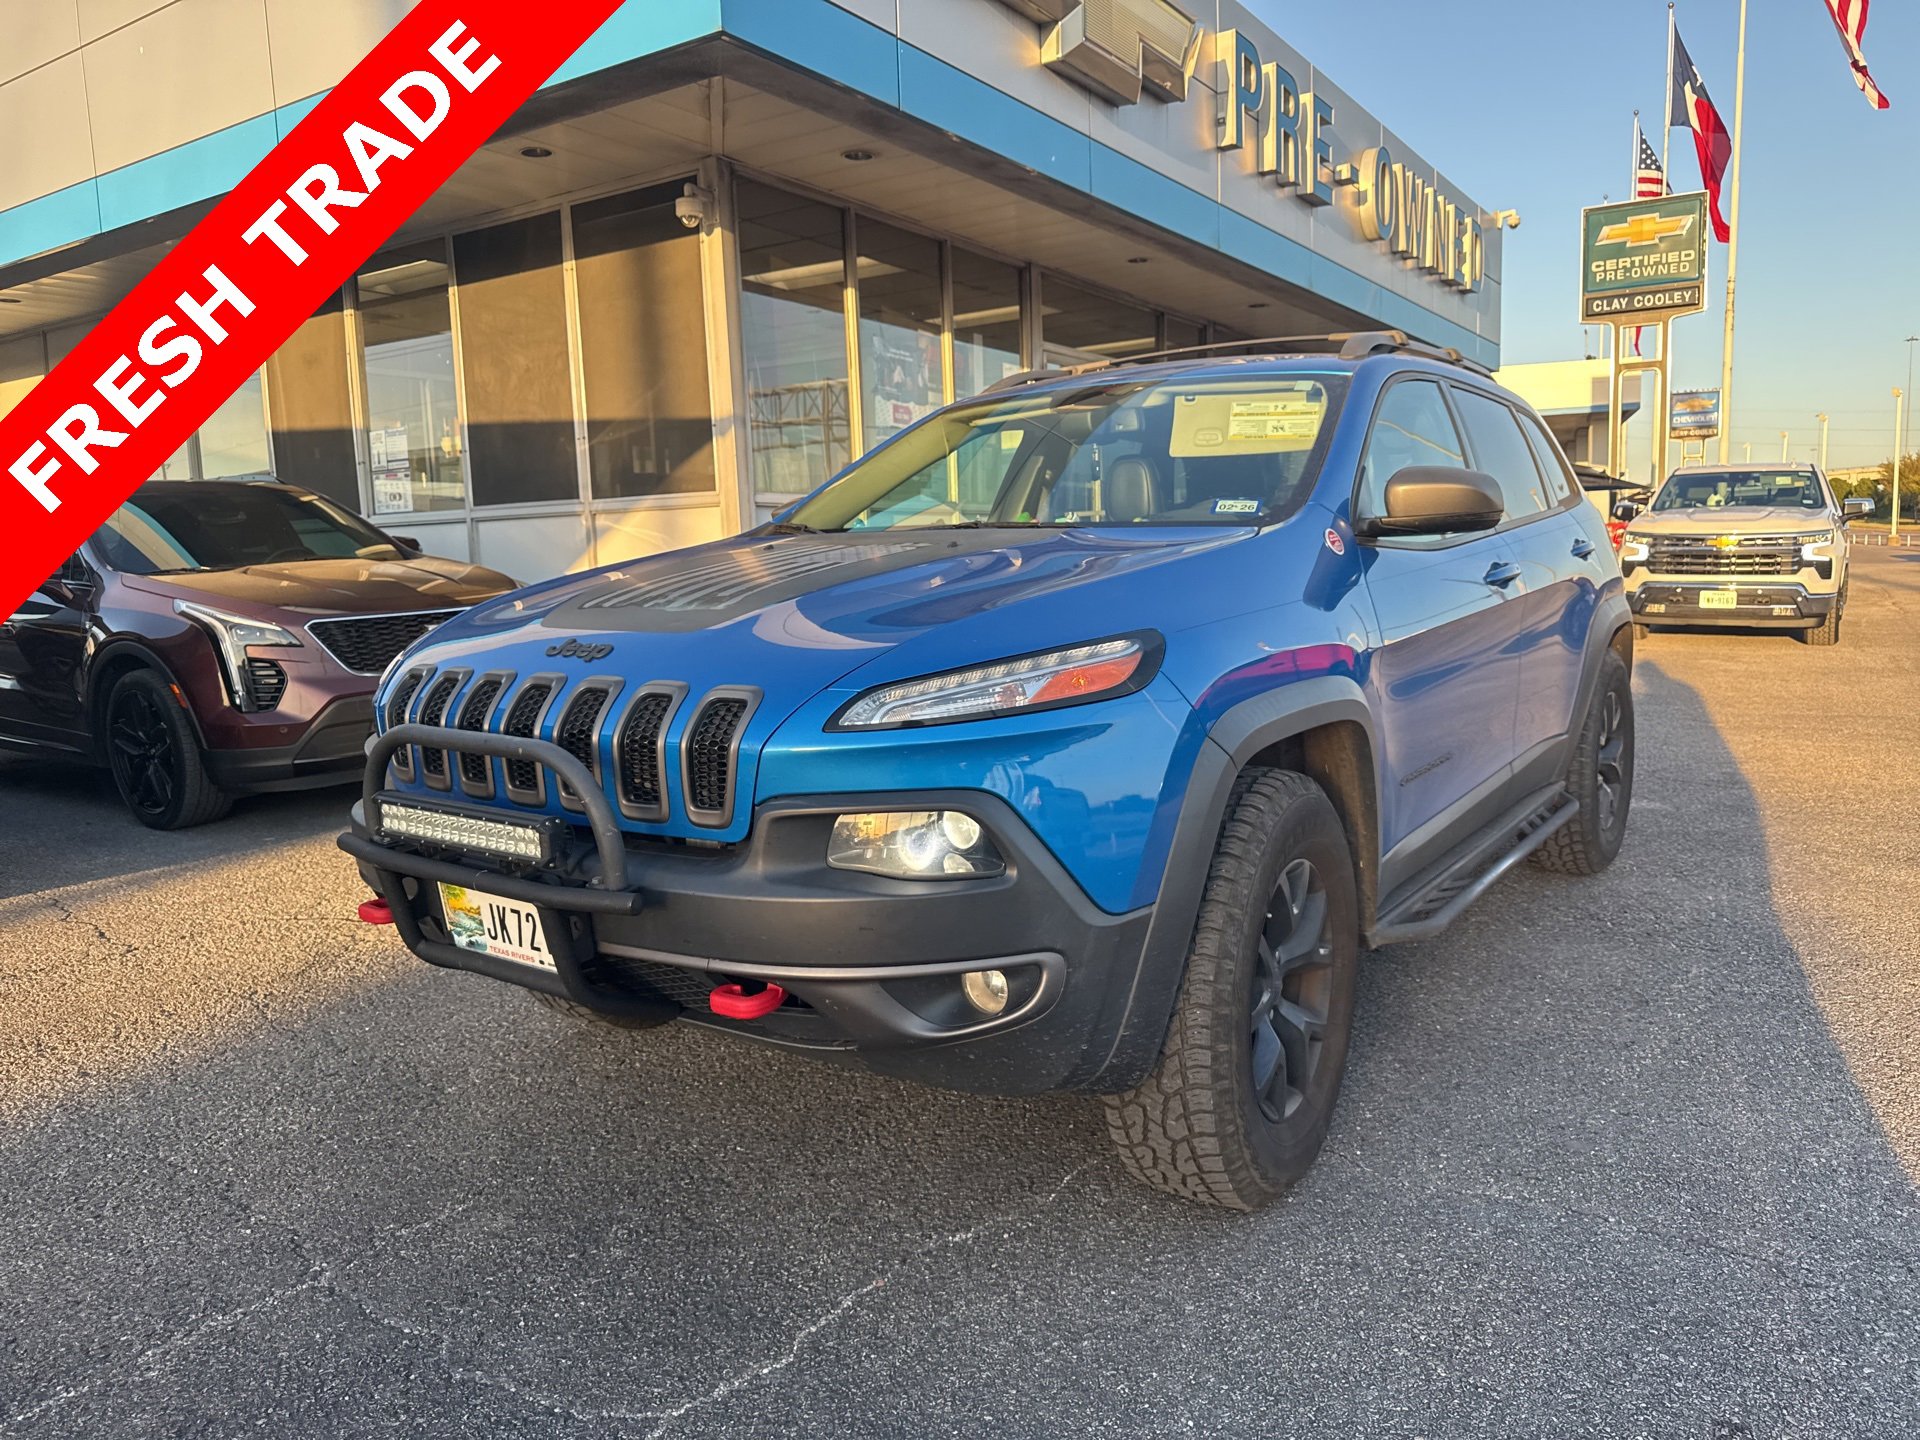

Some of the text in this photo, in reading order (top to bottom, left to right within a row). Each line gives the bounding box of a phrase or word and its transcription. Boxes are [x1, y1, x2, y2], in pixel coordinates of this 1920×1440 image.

[1591, 250, 1695, 272] CERTIFIED
[1596, 262, 1690, 282] PRE-OWNED
[1592, 291, 1692, 312] CLAY COOLEY
[545, 638, 615, 663] Jeep
[487, 903, 542, 952] JK72
[489, 945, 536, 963] TEXAS RIVERS
